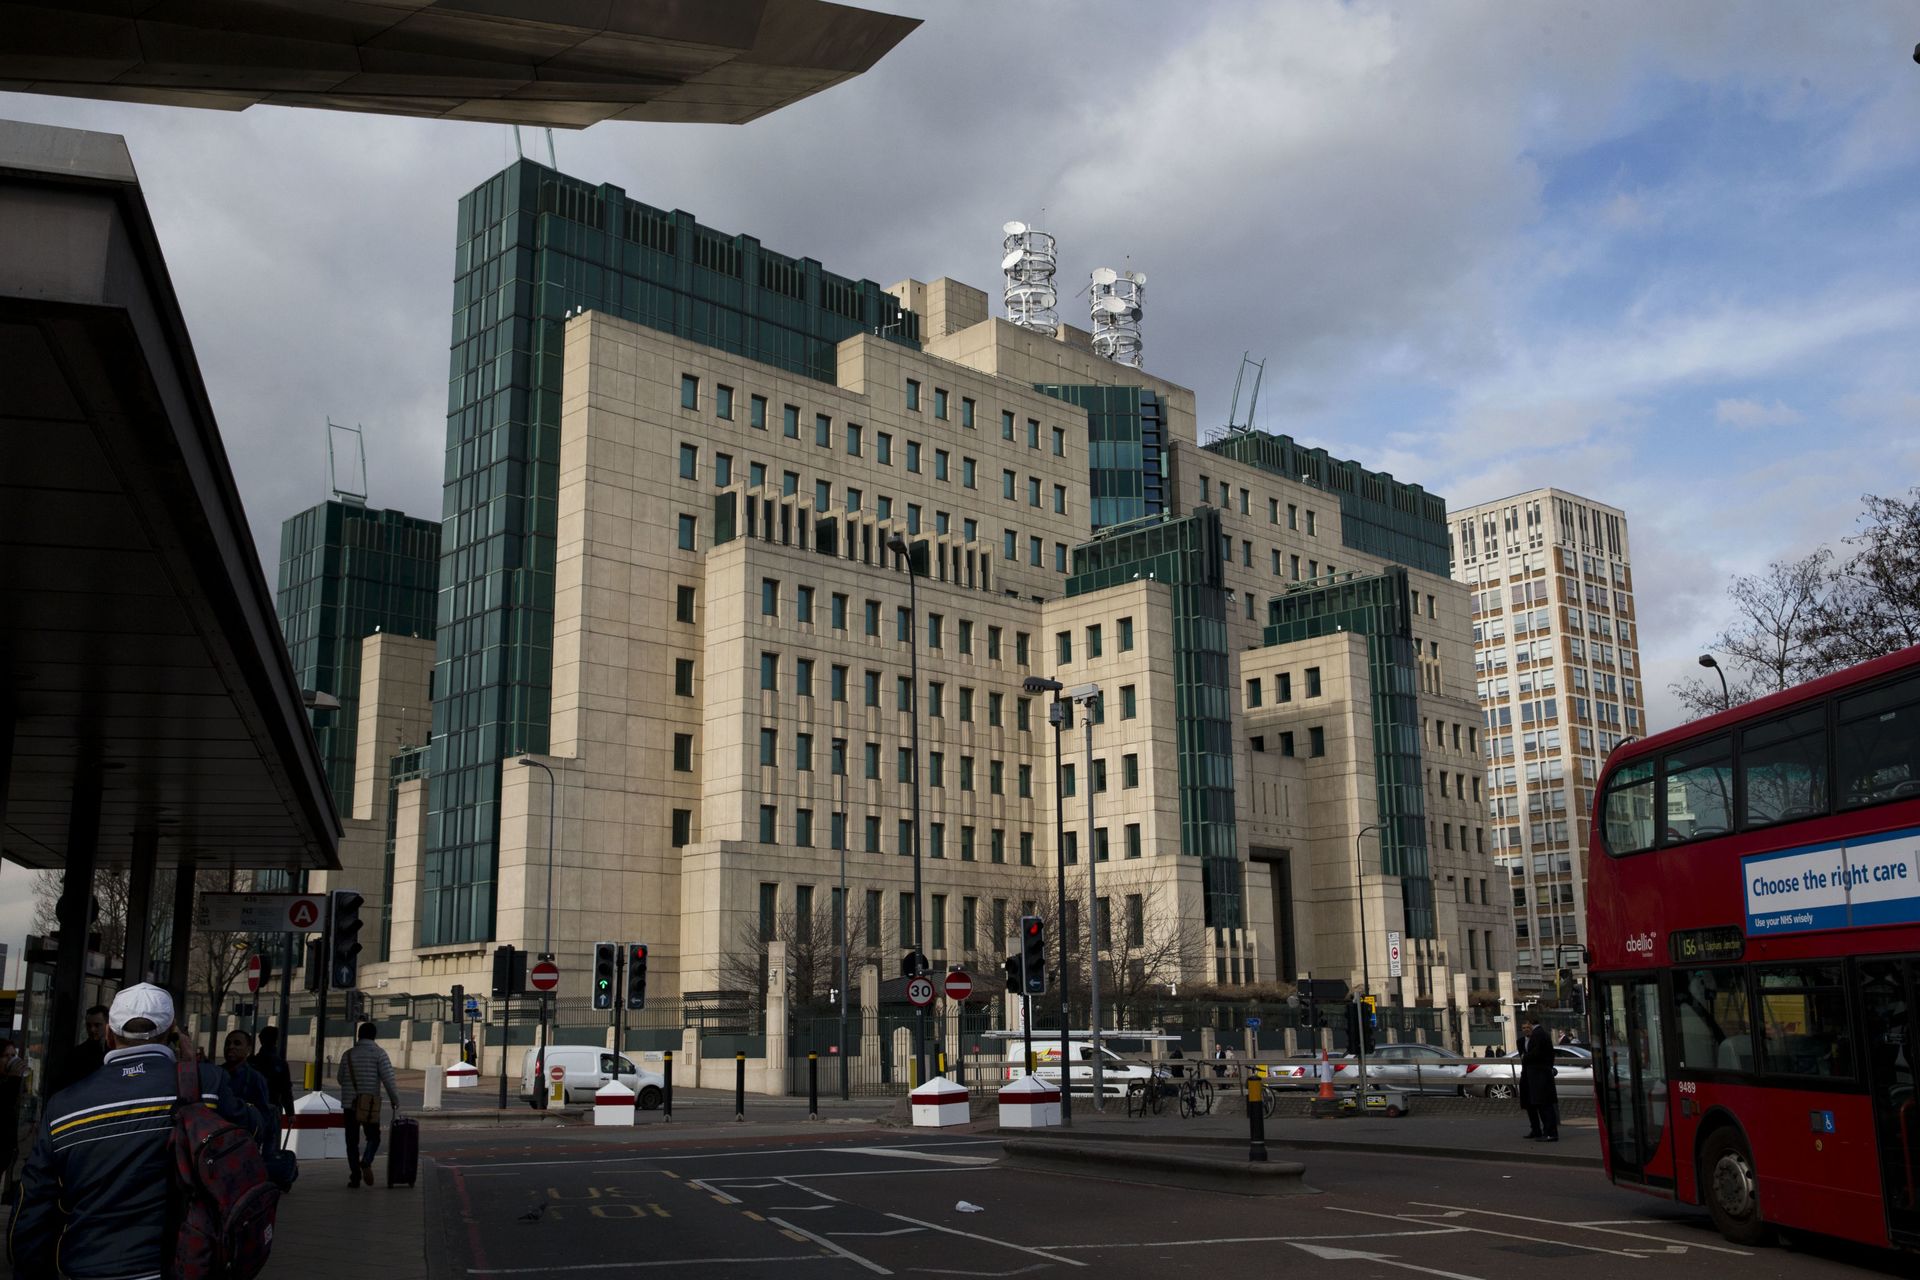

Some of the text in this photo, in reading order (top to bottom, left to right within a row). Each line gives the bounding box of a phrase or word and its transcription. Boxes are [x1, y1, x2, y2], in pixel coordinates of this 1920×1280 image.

[1753, 862, 1907, 896] Choose the right care
[294, 905, 313, 923] A
[1754, 912, 1813, 928] Use your NHS wisely
[1625, 933, 1653, 953] abellio
[1682, 938, 1697, 956] 156
[911, 985, 931, 998] 30
[1678, 1081, 1696, 1095] 9489
